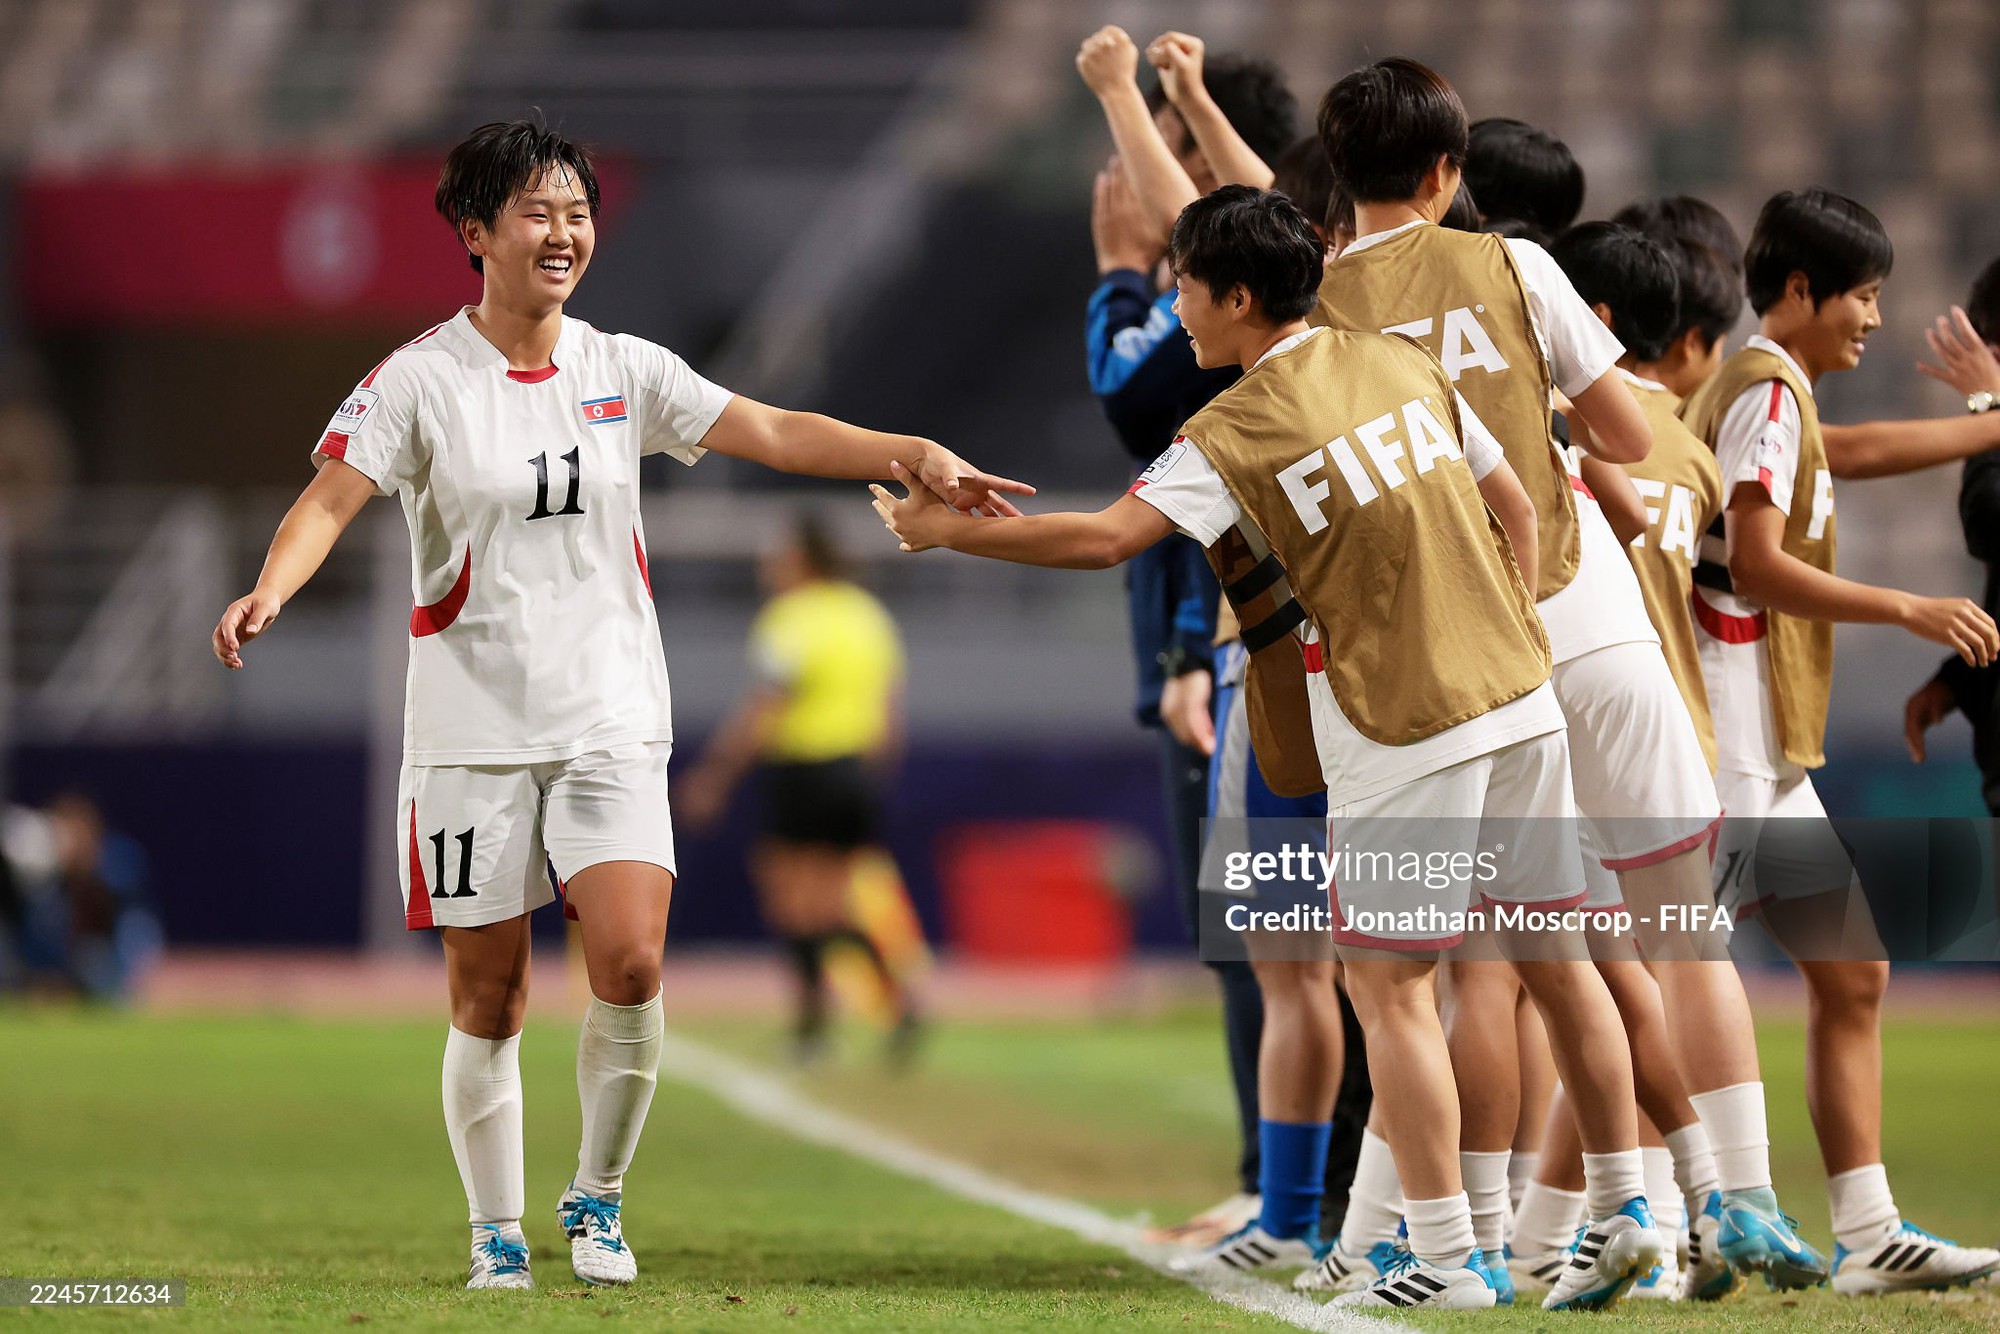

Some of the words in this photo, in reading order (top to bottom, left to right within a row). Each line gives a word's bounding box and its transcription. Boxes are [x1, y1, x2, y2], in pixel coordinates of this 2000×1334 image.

[525, 445, 585, 521] 11
[1275, 398, 1465, 536] FIFA
[428, 826, 478, 898] 11
